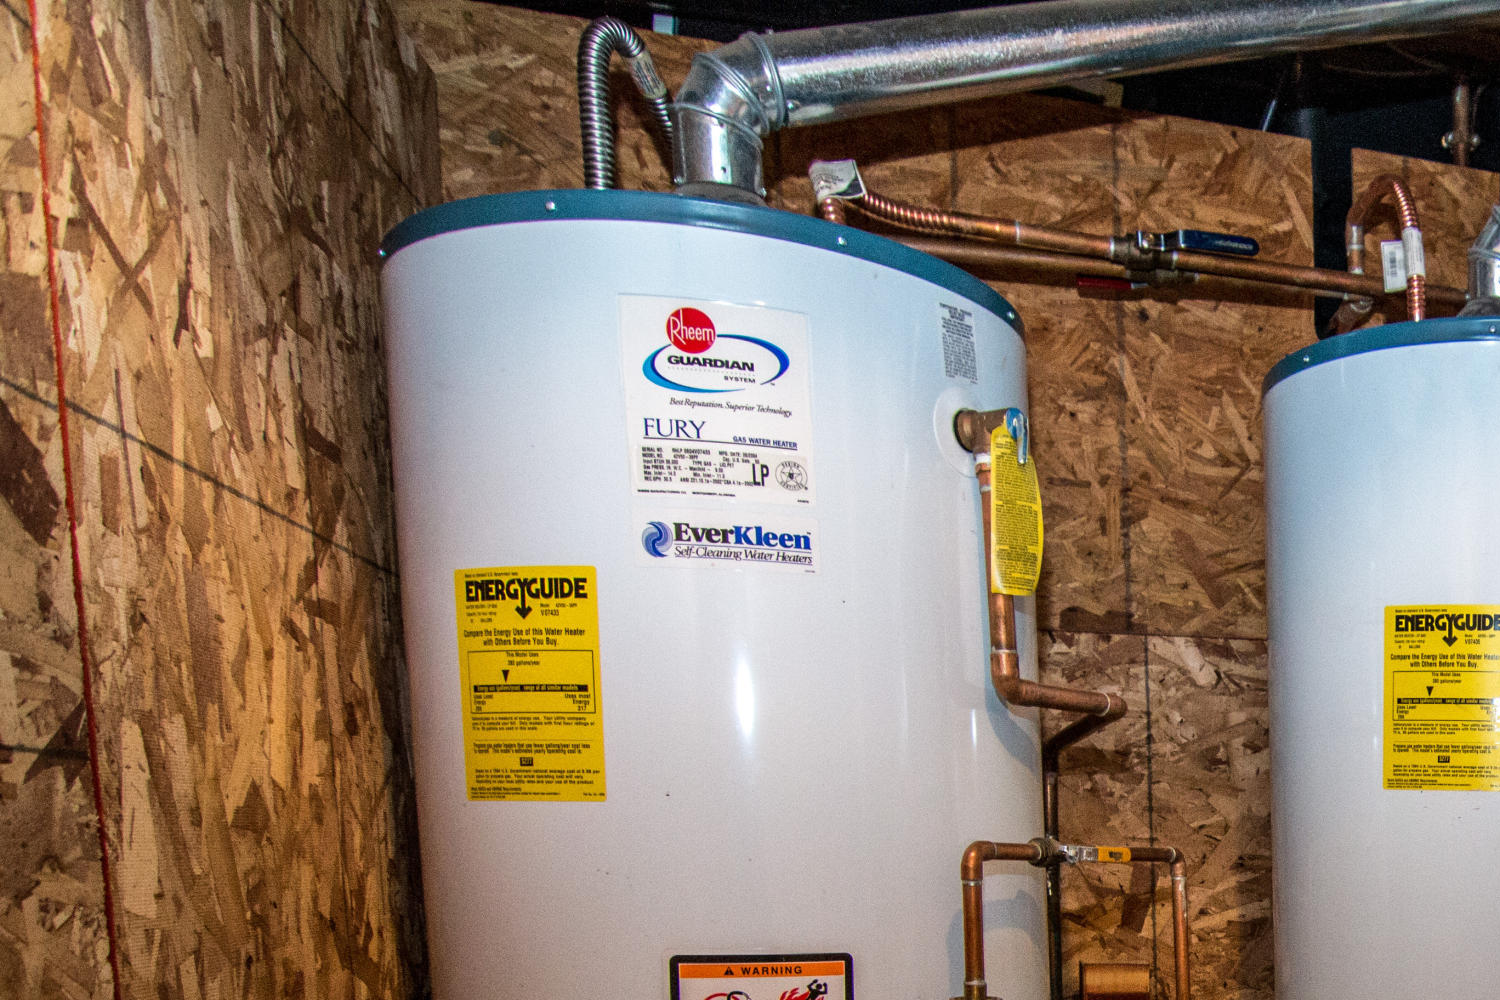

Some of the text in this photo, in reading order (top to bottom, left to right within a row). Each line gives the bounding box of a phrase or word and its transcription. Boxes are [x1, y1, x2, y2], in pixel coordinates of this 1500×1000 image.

[670, 308, 714, 345] Rheem
[667, 355, 754, 372] GUARDIAN
[724, 375, 756, 384] SYSTEM
[670, 397, 683, 405] Best
[684, 398, 723, 409] Reputation.
[725, 402, 755, 412] Superior
[644, 418, 706, 439] FURY
[749, 437, 771, 446] WATER
[772, 439, 798, 448] HEATER
[752, 463, 770, 487] LP
[675, 546, 812, 564] Self-Cleaning Water Heaters
[465, 578, 588, 602] ENERGYGUIDE
[494, 629, 511, 637] Energy
[742, 965, 802, 975] WARNING
